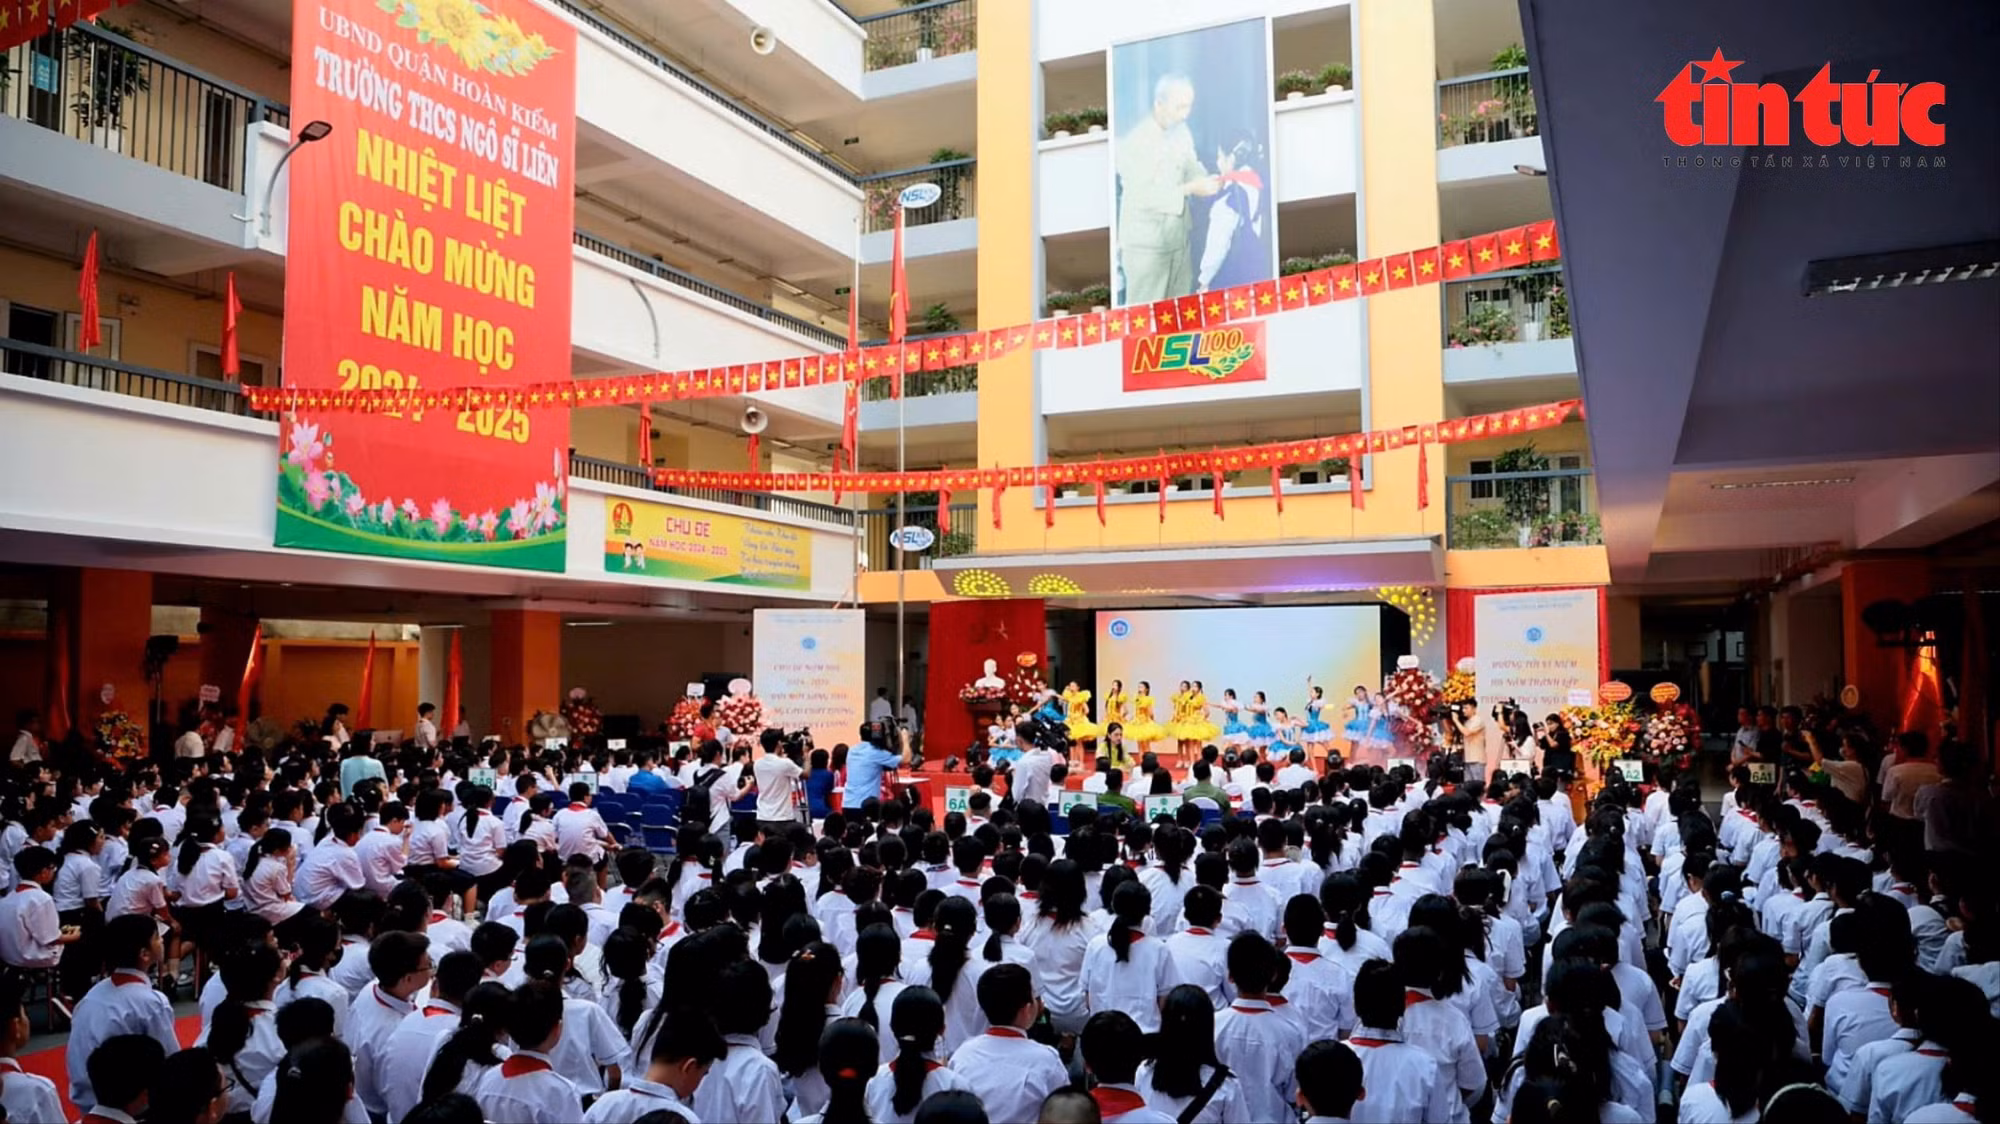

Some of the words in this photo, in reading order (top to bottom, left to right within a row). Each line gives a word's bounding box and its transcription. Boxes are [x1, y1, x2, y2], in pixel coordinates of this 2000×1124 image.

[313, 45, 404, 121] TRƯỜNG
[407, 89, 457, 145] THCS
[460, 115, 499, 163] NGÔ
[502, 126, 520, 173] SĨ
[521, 141, 559, 189] LIÊN
[319, 6, 383, 54] UBND
[387, 41, 447, 86] QUẬN
[453, 72, 506, 116] HOÀN
[511, 102, 559, 141] KIẾM
[356, 127, 458, 213] NHIỆT
[466, 173, 527, 239] LIỆT
[338, 200, 435, 275] CHÀO
[444, 236, 536, 309] MỪNG
[361, 284, 443, 352] NĂM
[453, 312, 515, 375] HỌC
[949, 798, 967, 810] 6A
